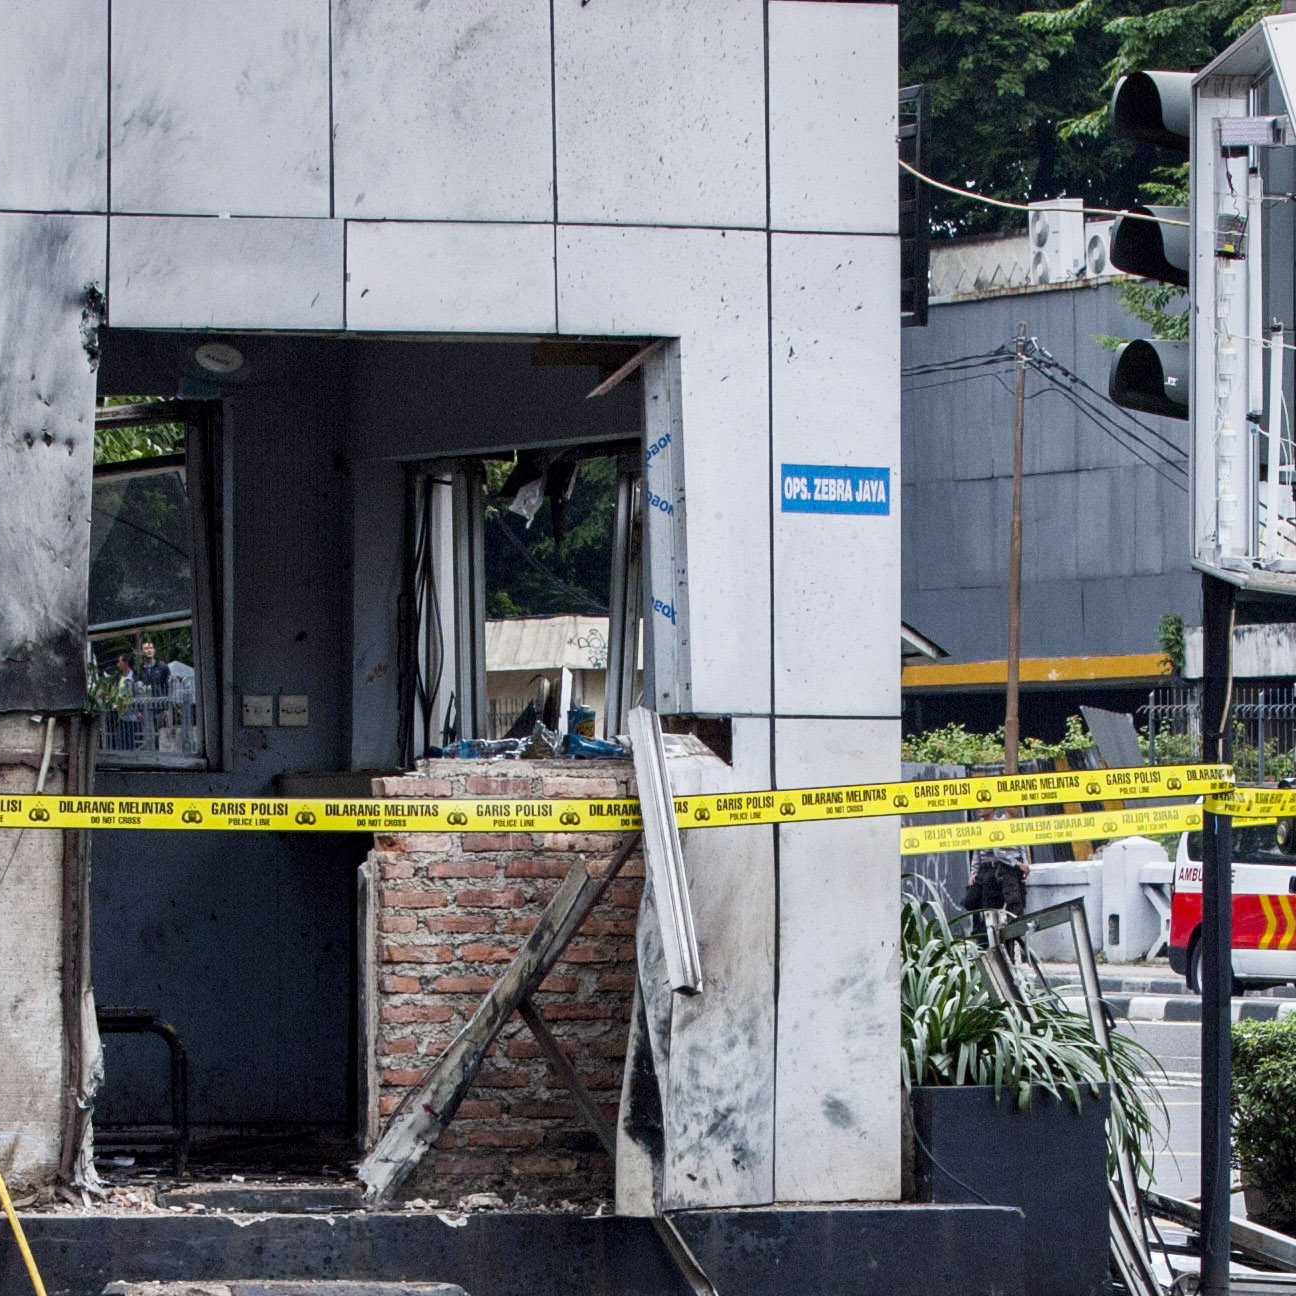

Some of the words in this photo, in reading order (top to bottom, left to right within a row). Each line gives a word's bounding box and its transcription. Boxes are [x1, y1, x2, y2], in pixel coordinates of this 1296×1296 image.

[784, 476, 811, 500] OPS.
[813, 478, 853, 501] ZEBRA
[855, 480, 886, 503] JAYA
[998, 777, 1038, 793] DILARANG
[1040, 775, 1080, 790] MELINTAS
[1106, 771, 1132, 786] GARIS
[1134, 770, 1162, 784] POLISI
[802, 790, 844, 806] DILARANG
[846, 788, 888, 803] MELINTAS
[914, 784, 940, 799] GARIS
[944, 782, 970, 797] POLISI
[60, 800, 114, 814] DILARANG
[118, 801, 174, 815] MELINTAS
[212, 802, 246, 816] GARIS
[250, 803, 288, 816] POLISI
[326, 803, 380, 816] DILARANG
[384, 804, 438, 816] MELINTAS
[476, 804, 510, 816] GARIS
[516, 804, 552, 816] POLISI
[716, 796, 742, 811] GARIS
[746, 795, 774, 809] POLISI
